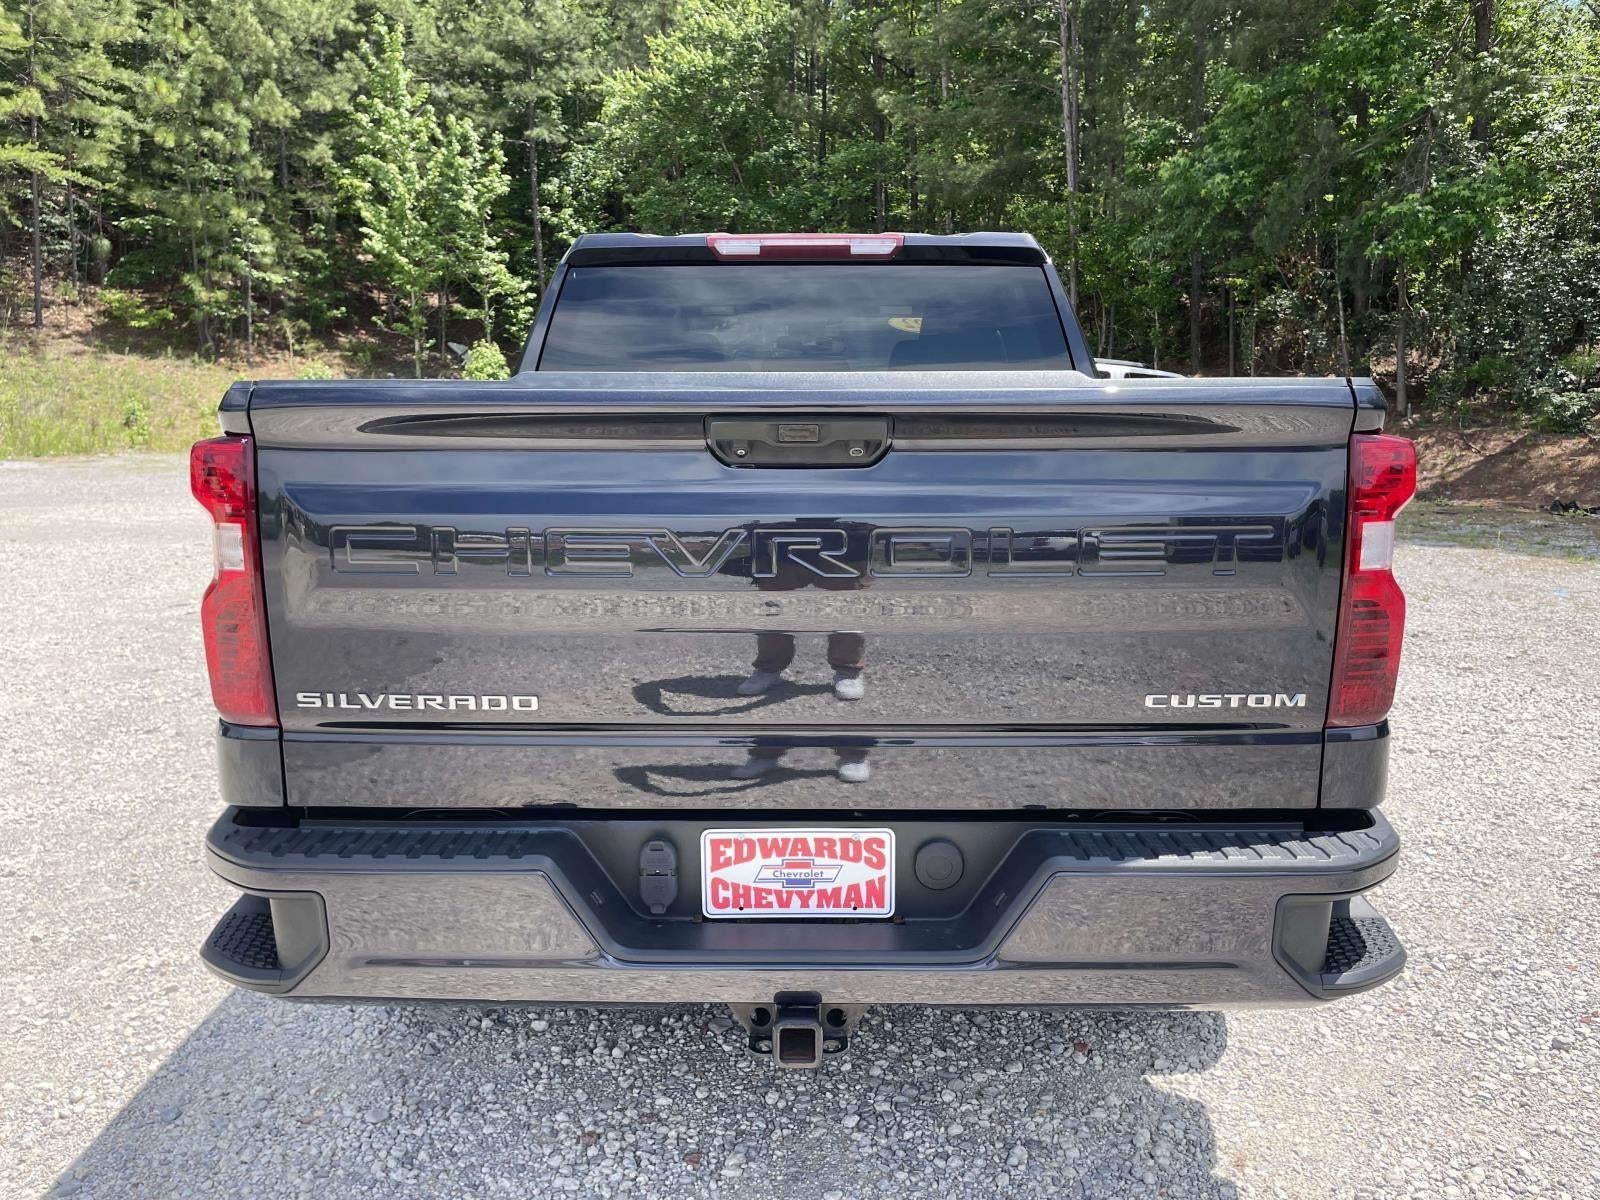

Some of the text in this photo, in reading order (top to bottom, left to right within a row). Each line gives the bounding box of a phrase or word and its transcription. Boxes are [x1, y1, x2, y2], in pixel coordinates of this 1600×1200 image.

[330, 526, 1275, 578] CHEVROLET
[296, 692, 539, 711] SILVERADO
[1144, 693, 1307, 708] CUSTOM
[710, 837, 886, 873] EDWARDS
[772, 869, 824, 878] Chevrolet
[711, 875, 887, 909] CHEVYMAN
